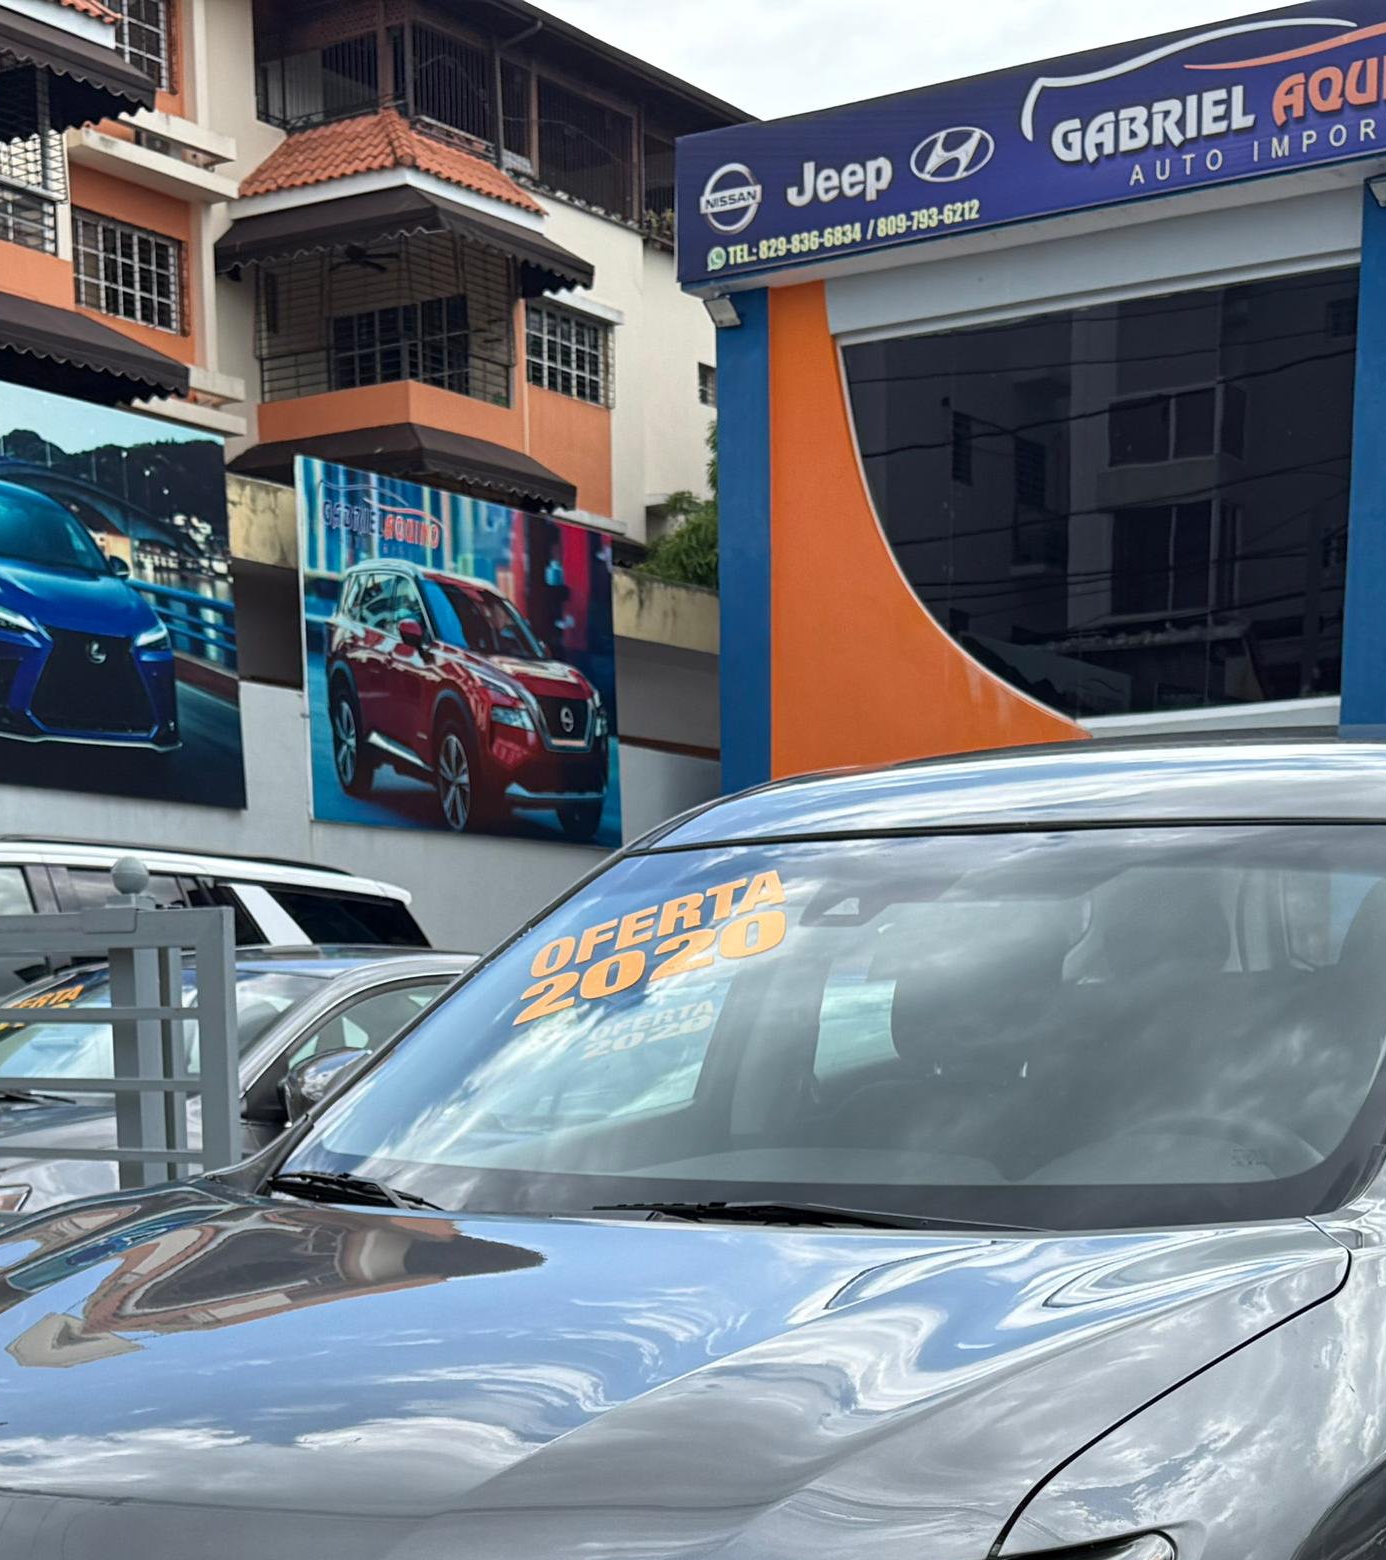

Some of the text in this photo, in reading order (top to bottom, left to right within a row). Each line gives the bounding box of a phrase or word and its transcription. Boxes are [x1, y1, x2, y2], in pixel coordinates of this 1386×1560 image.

[1050, 83, 1256, 164] GABRIEL
[786, 156, 894, 207] Jeep
[1129, 148, 1224, 187] AUTO
[704, 188, 758, 210] NISSAN
[759, 222, 862, 260] 829-836-6834
[876, 199, 981, 239] 809-793-6212
[530, 869, 788, 978] OFERTA
[512, 909, 788, 1027] 2020
